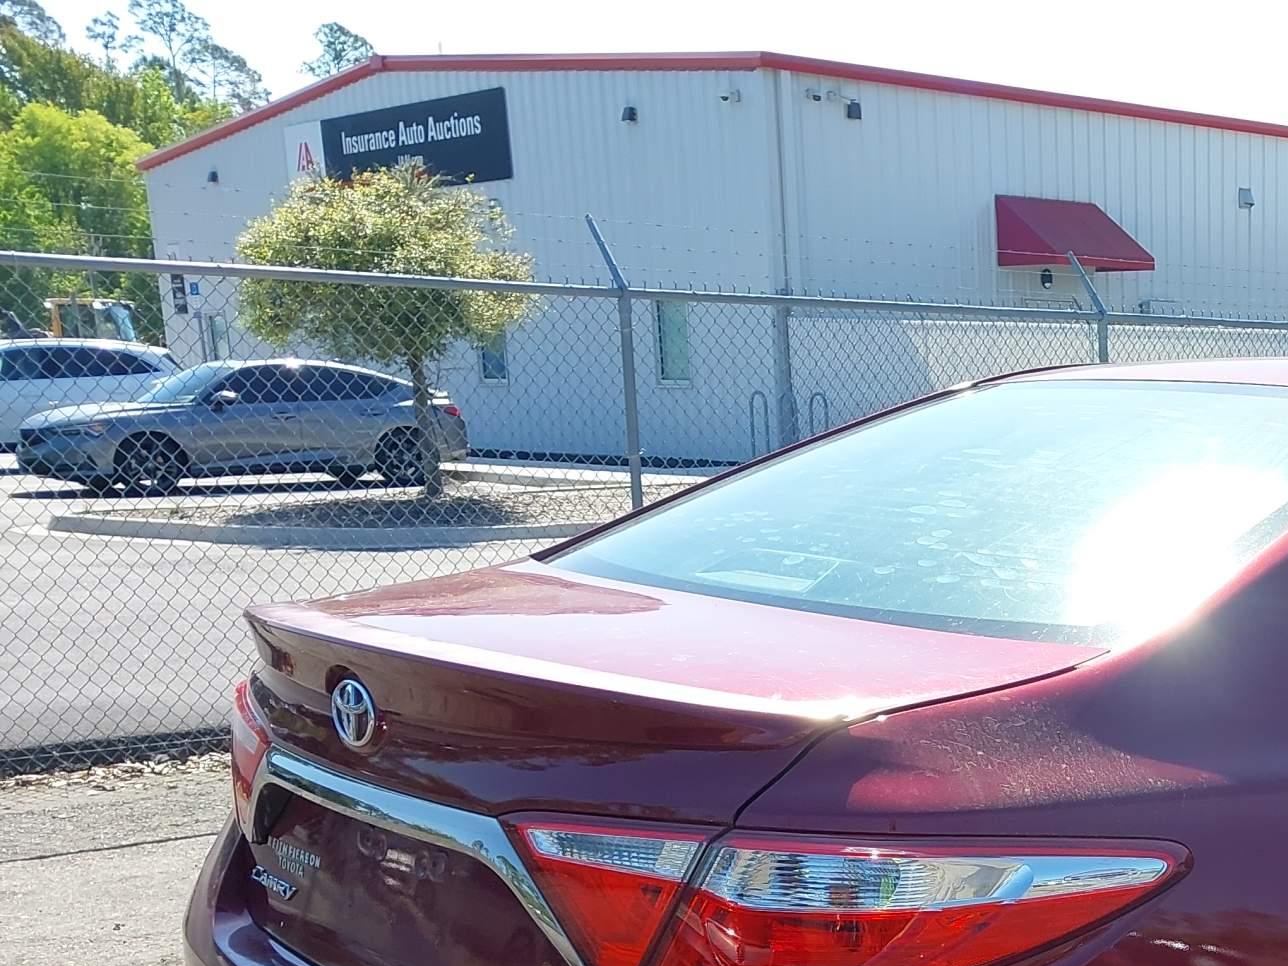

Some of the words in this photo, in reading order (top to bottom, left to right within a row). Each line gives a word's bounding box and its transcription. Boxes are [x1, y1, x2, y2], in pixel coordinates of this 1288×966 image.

[342, 131, 395, 155] Insurance
[398, 121, 424, 147] Auto
[427, 112, 482, 143] Auctions
[252, 865, 297, 900] CAMRY
